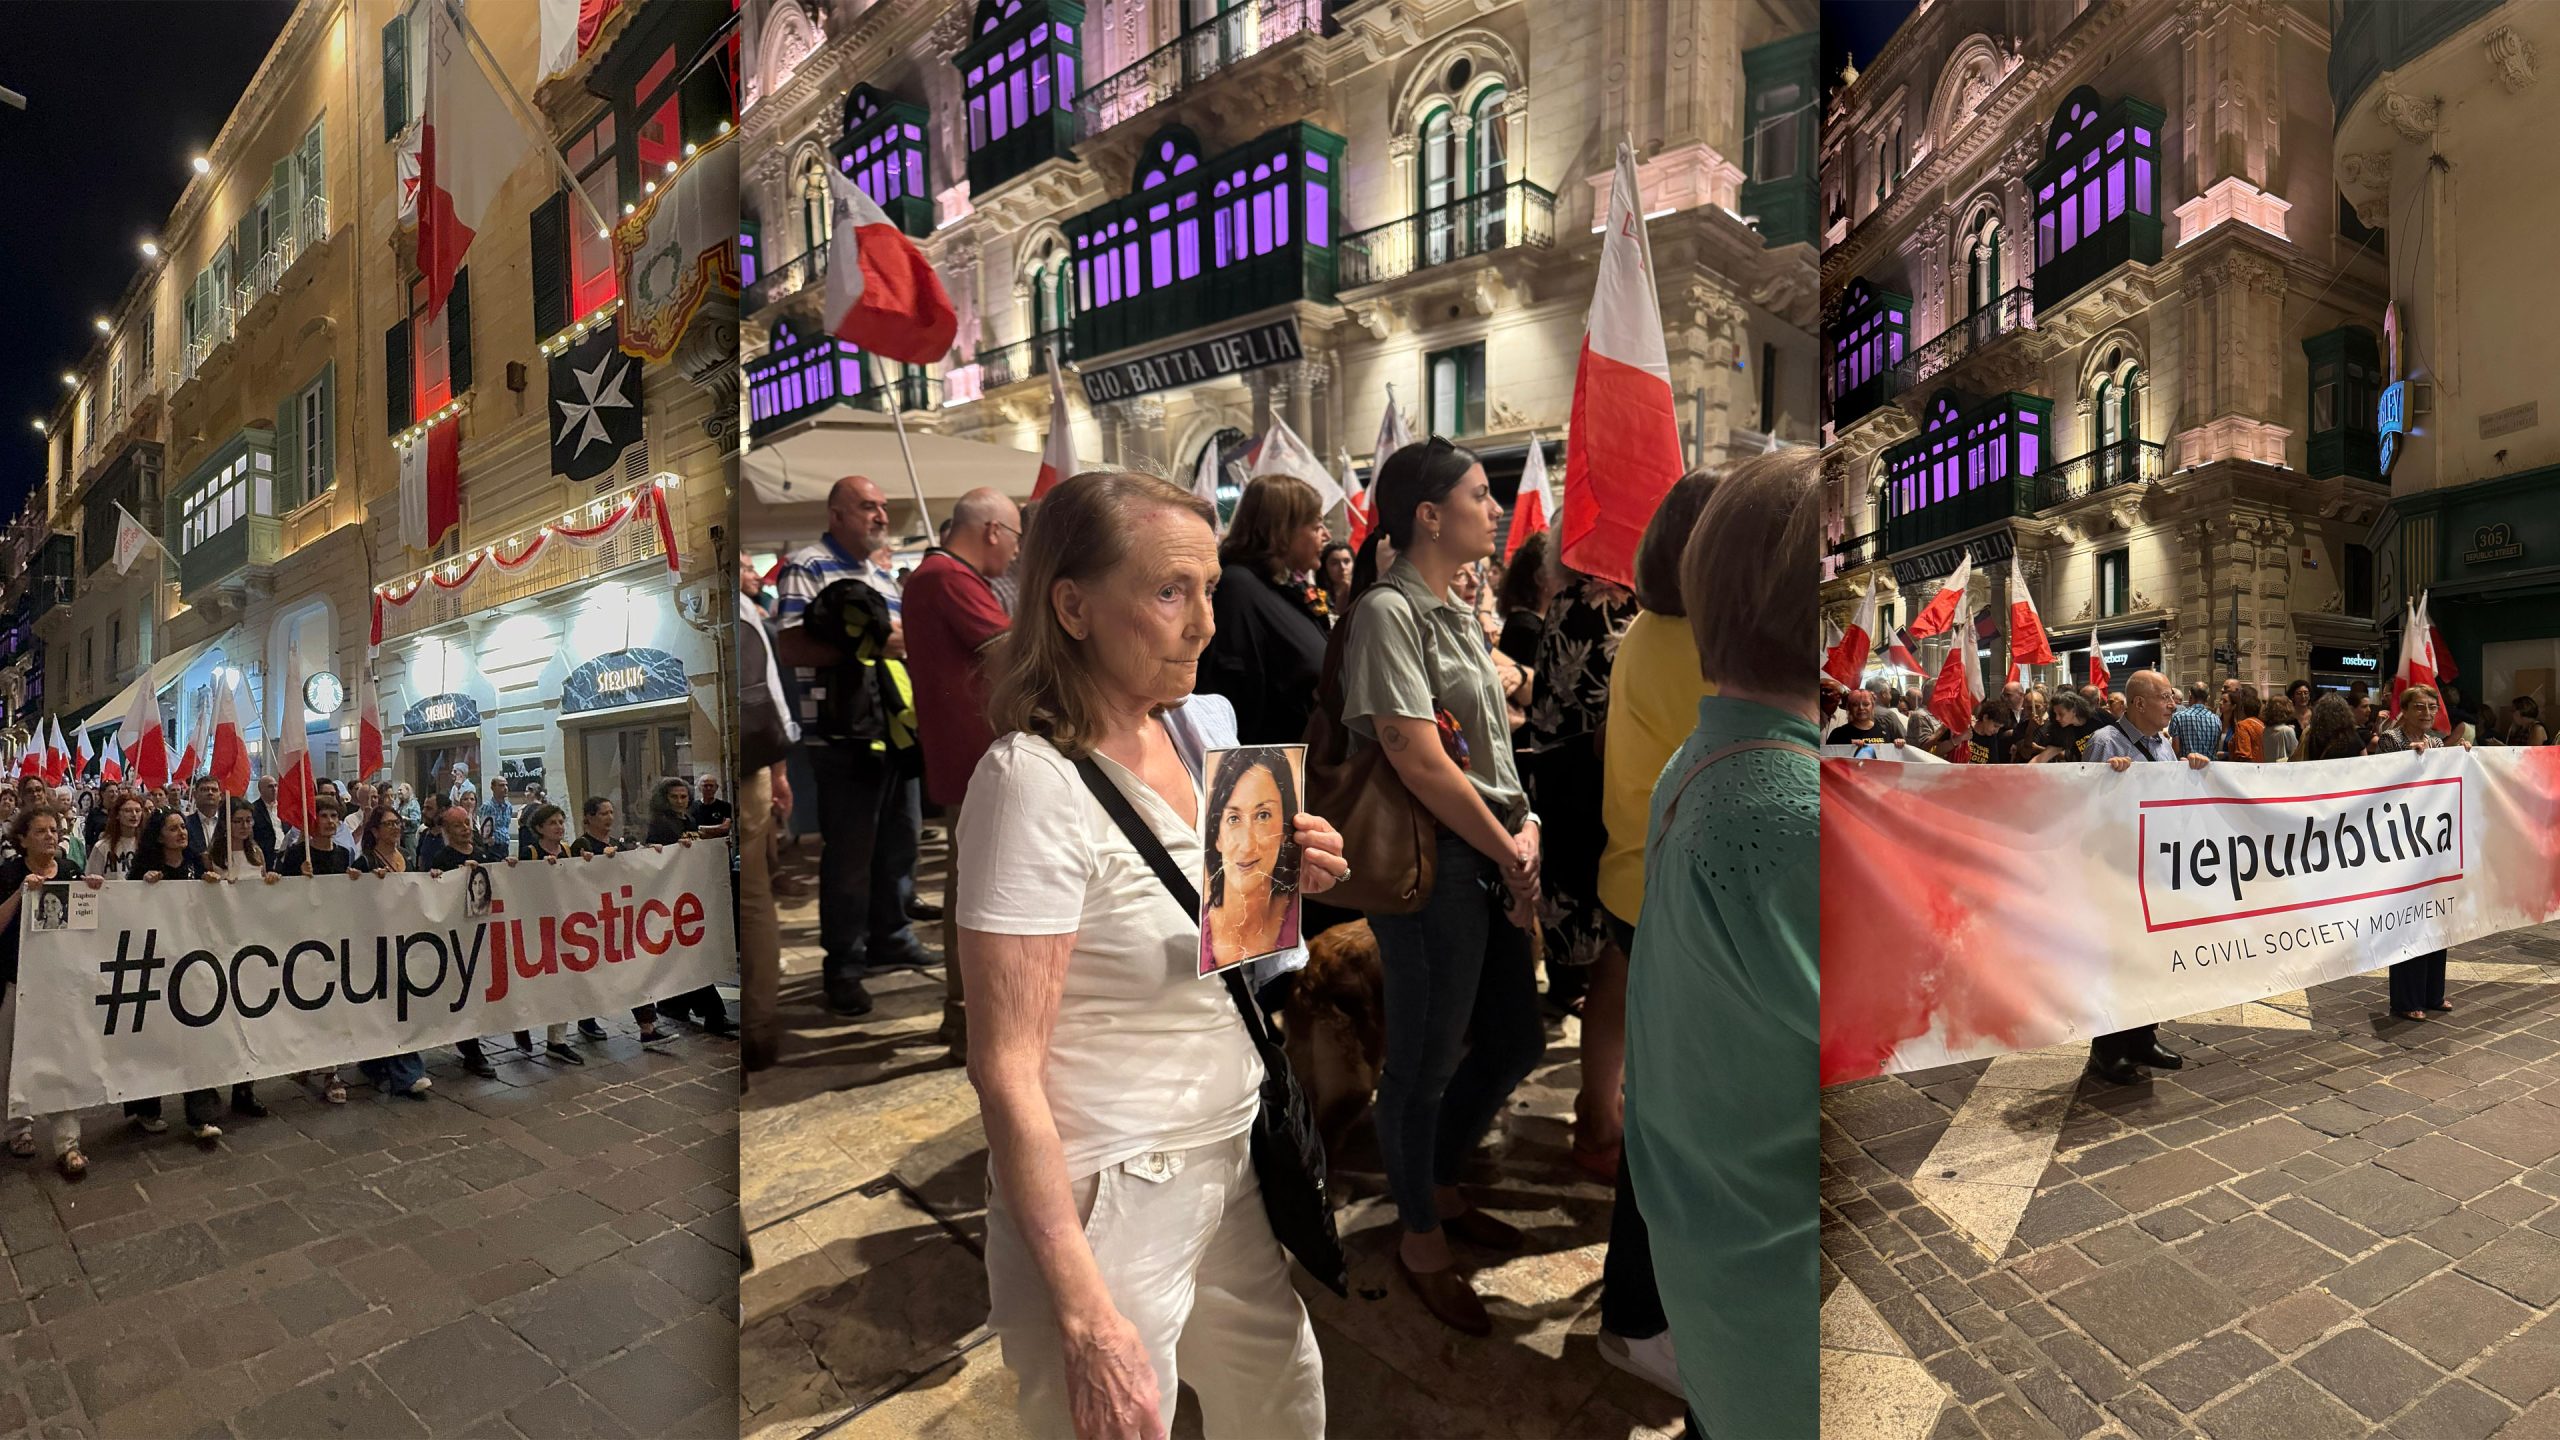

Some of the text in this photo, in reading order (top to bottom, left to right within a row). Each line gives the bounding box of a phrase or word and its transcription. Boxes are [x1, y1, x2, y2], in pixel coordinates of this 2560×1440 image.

[1085, 326, 1296, 401] GIO. BATTA DELIA
[1894, 534, 2013, 583] GIO. BATTA DELIA
[2480, 532, 2503, 548] 305
[2342, 653, 2377, 670] roseberry
[2160, 802, 2453, 901] repubblika
[95, 884, 706, 1036] #occupyjustice
[2171, 896, 2456, 973] A CIVIL SOCIETY MOVEMENT
